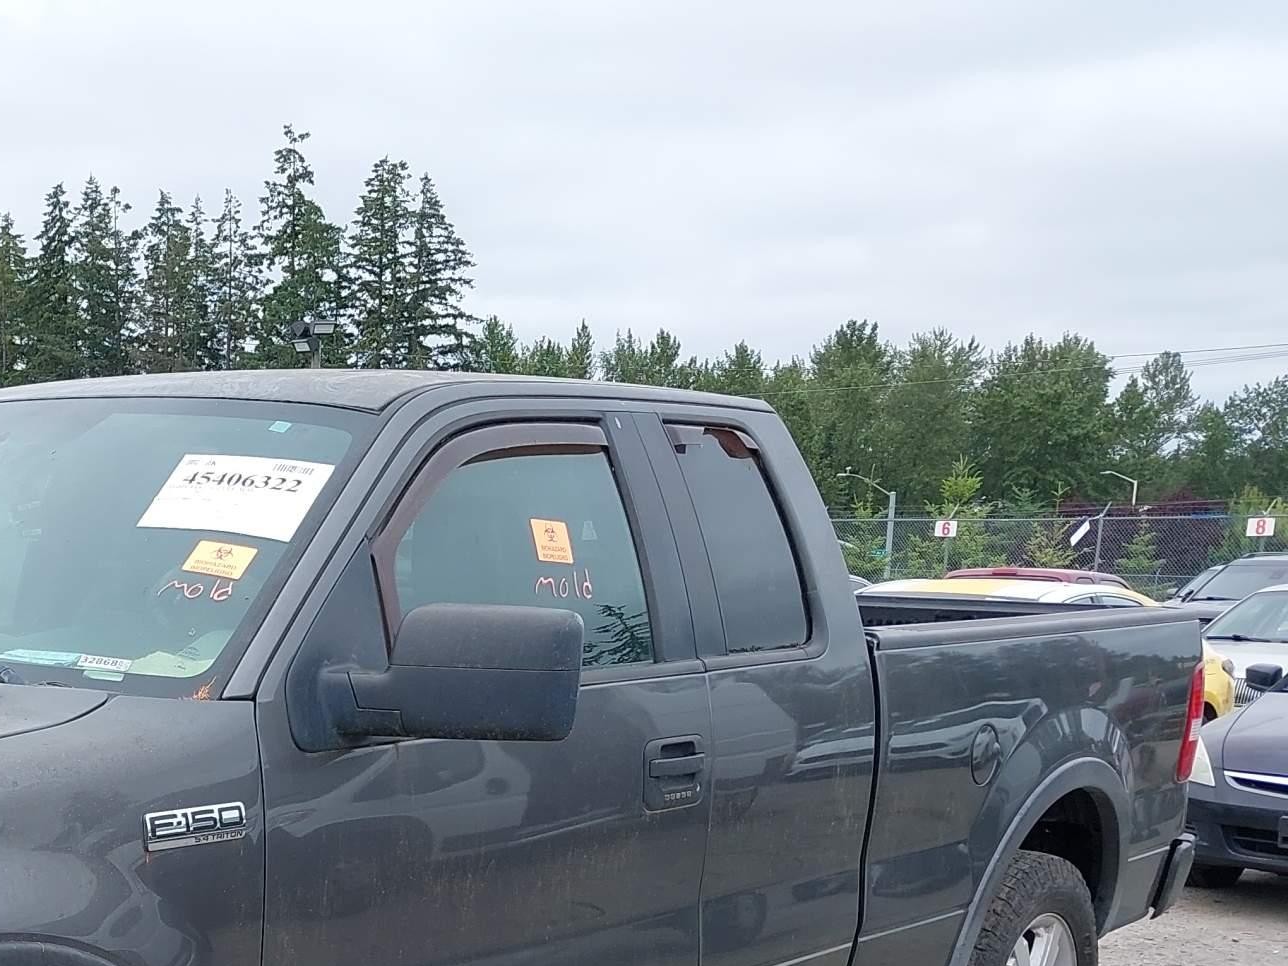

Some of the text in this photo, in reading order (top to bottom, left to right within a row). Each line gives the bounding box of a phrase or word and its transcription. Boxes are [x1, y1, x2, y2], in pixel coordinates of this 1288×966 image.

[183, 471, 303, 493] 45406322
[942, 521, 951, 536] 6
[1255, 519, 1266, 535] 8
[157, 579, 234, 601] mold
[535, 567, 593, 600] mold
[149, 805, 244, 838] F-150
[211, 830, 243, 840] TRITON
